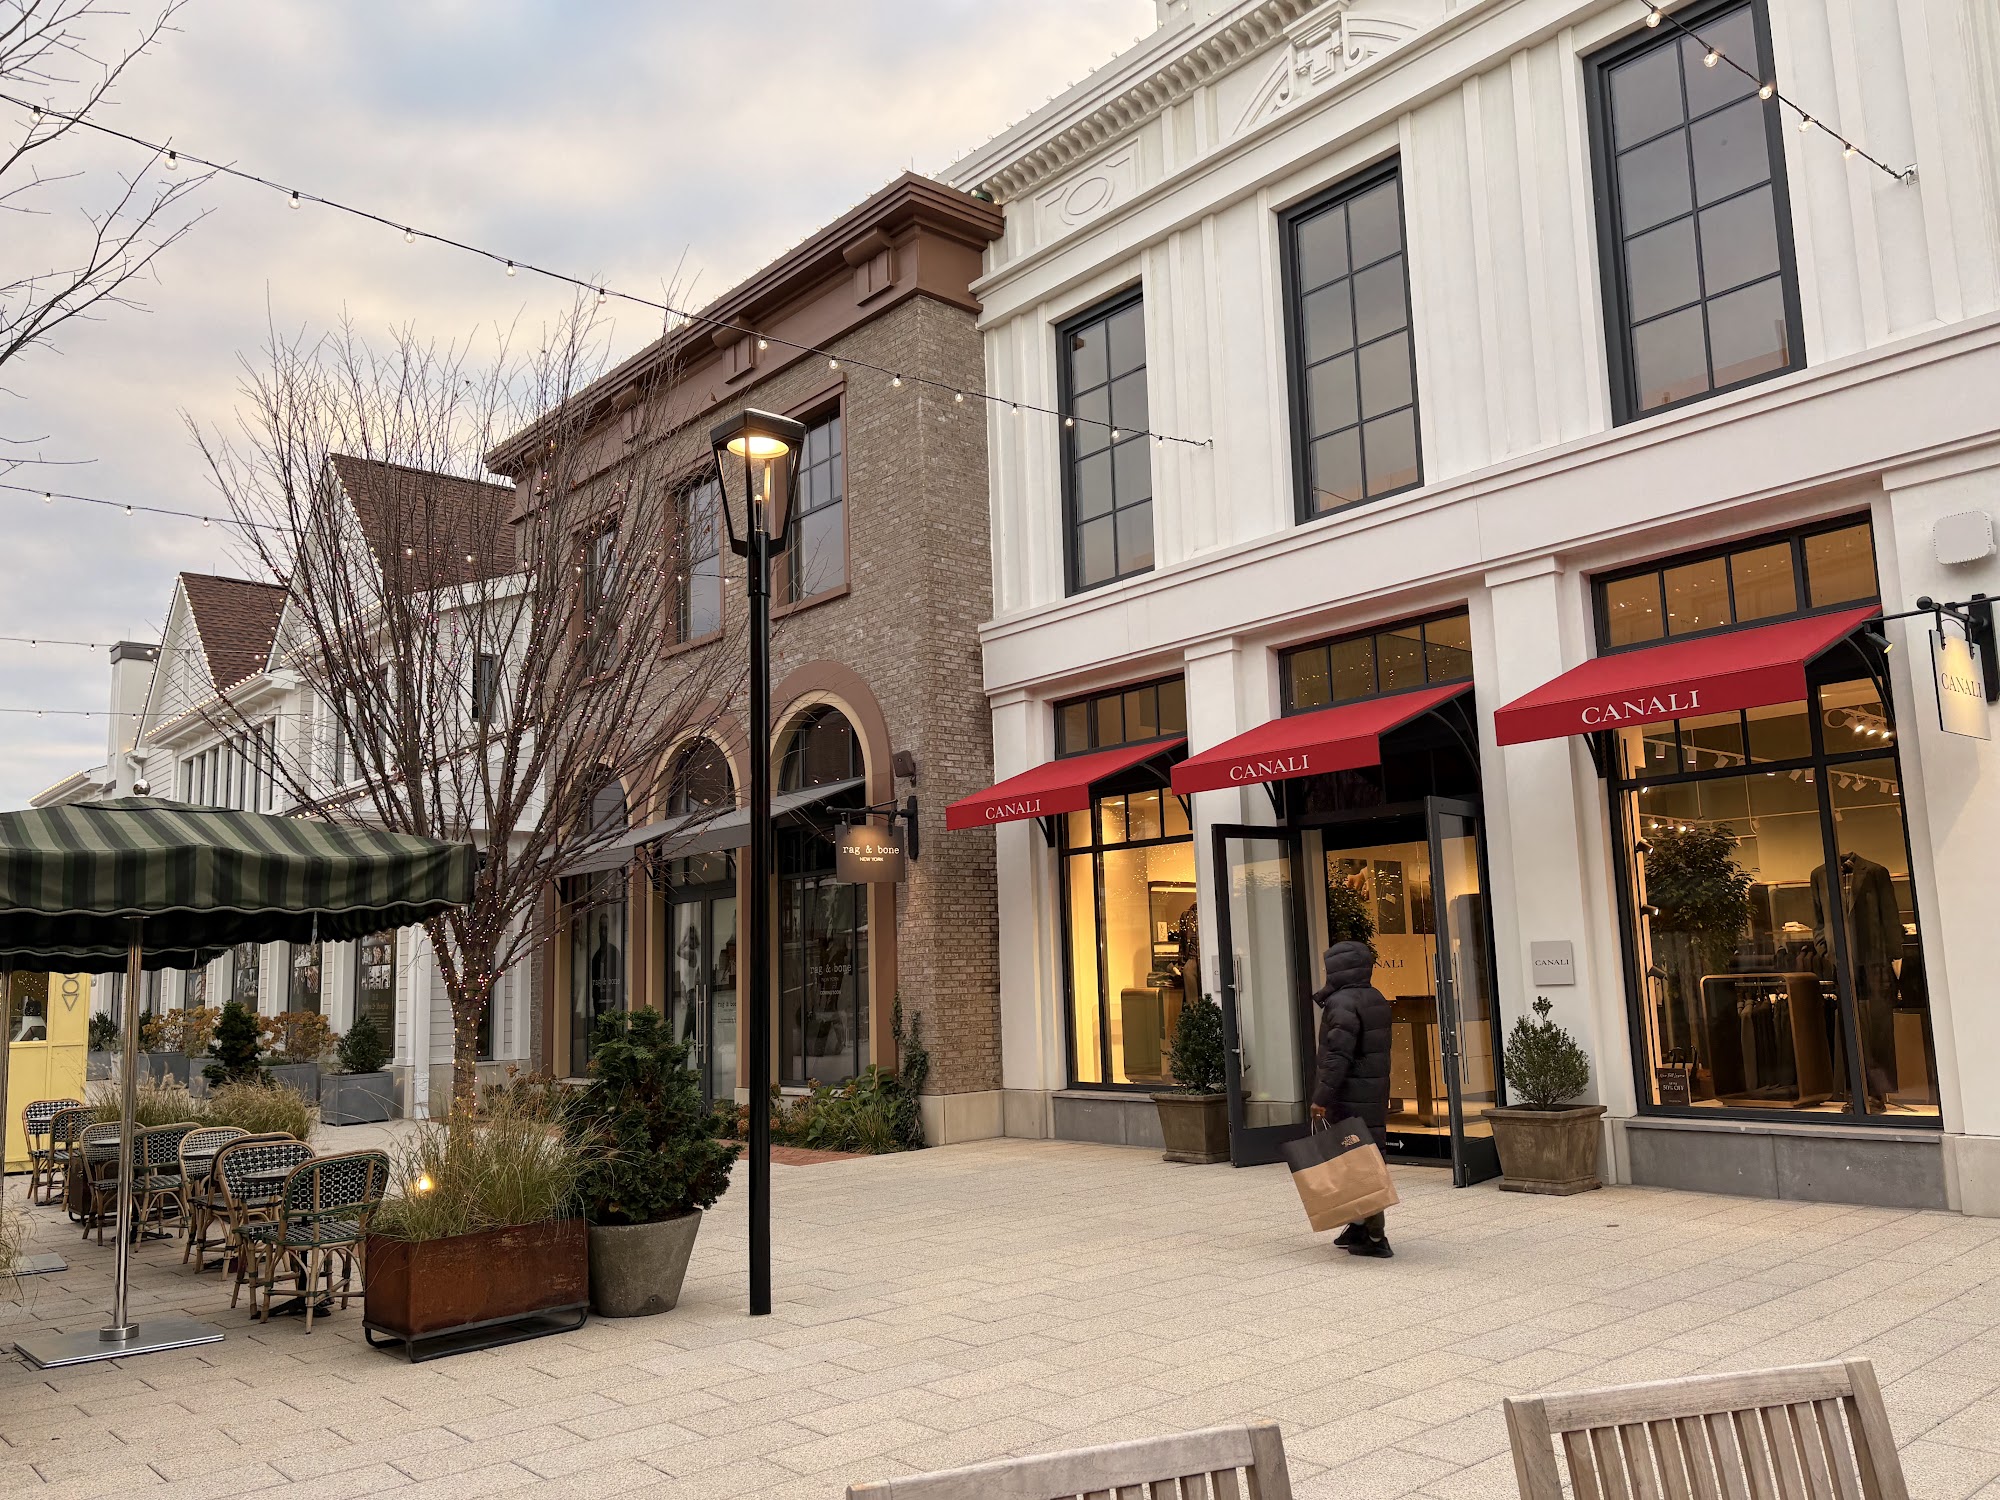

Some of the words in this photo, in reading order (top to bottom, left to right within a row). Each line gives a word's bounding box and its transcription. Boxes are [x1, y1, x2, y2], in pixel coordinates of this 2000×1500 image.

[1941, 672, 1983, 698] CANALI
[1581, 689, 1701, 725] CANALI
[1229, 754, 1310, 781] CANALI
[985, 799, 1041, 820] CANALI
[842, 846, 860, 855] rag
[865, 845, 873, 854] &
[877, 845, 900, 854] bone
[810, 965, 823, 976] rag
[825, 963, 832, 973] &
[833, 962, 852, 973] bone
[1374, 959, 1404, 968] NALI
